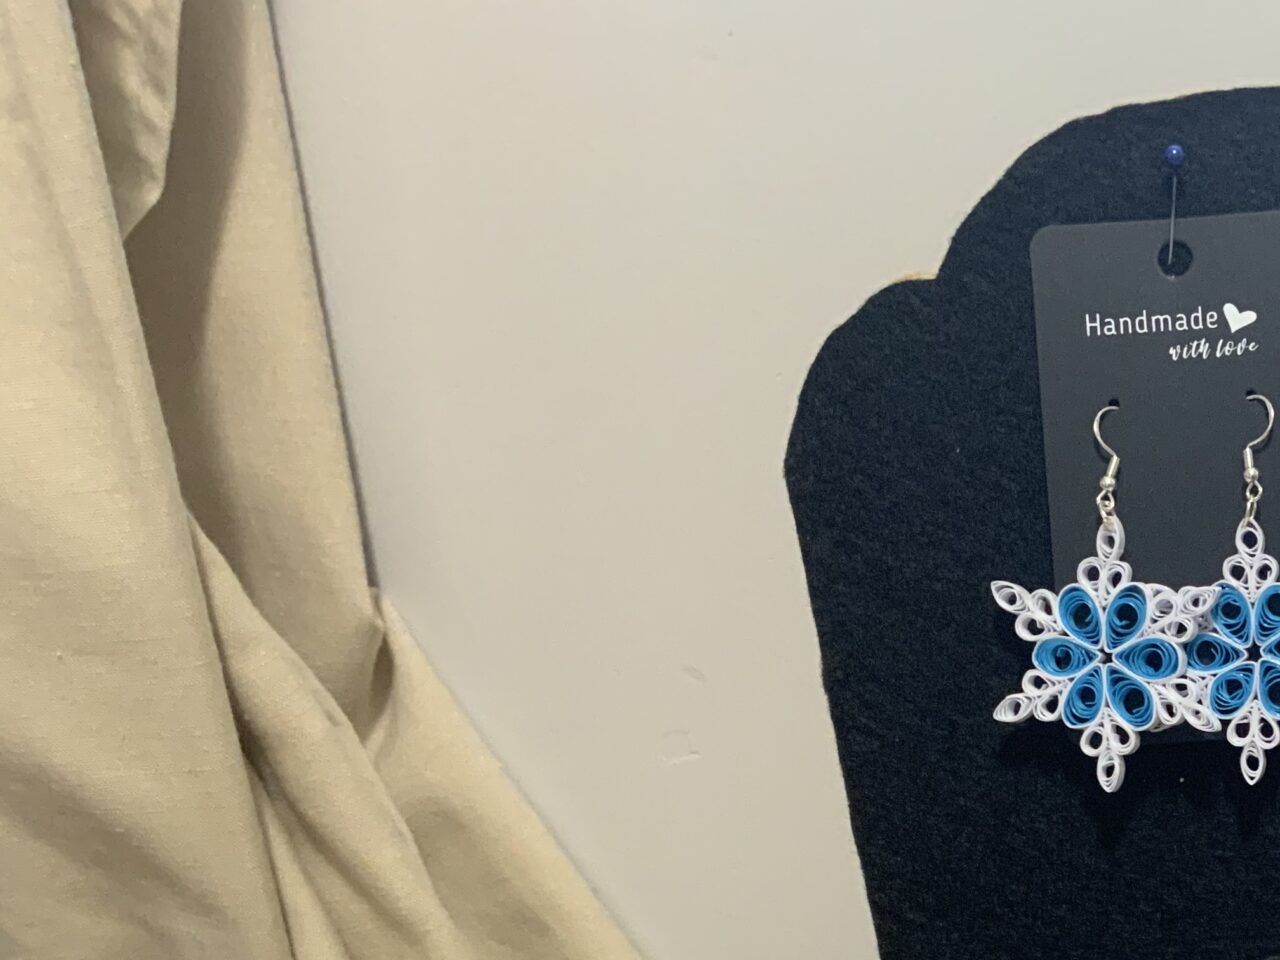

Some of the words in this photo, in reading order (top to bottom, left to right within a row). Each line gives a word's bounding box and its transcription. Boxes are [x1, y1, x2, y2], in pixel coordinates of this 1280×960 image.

[1085, 305, 1219, 337] Handmade
[1168, 337, 1211, 362] with
[1215, 337, 1260, 359] love
